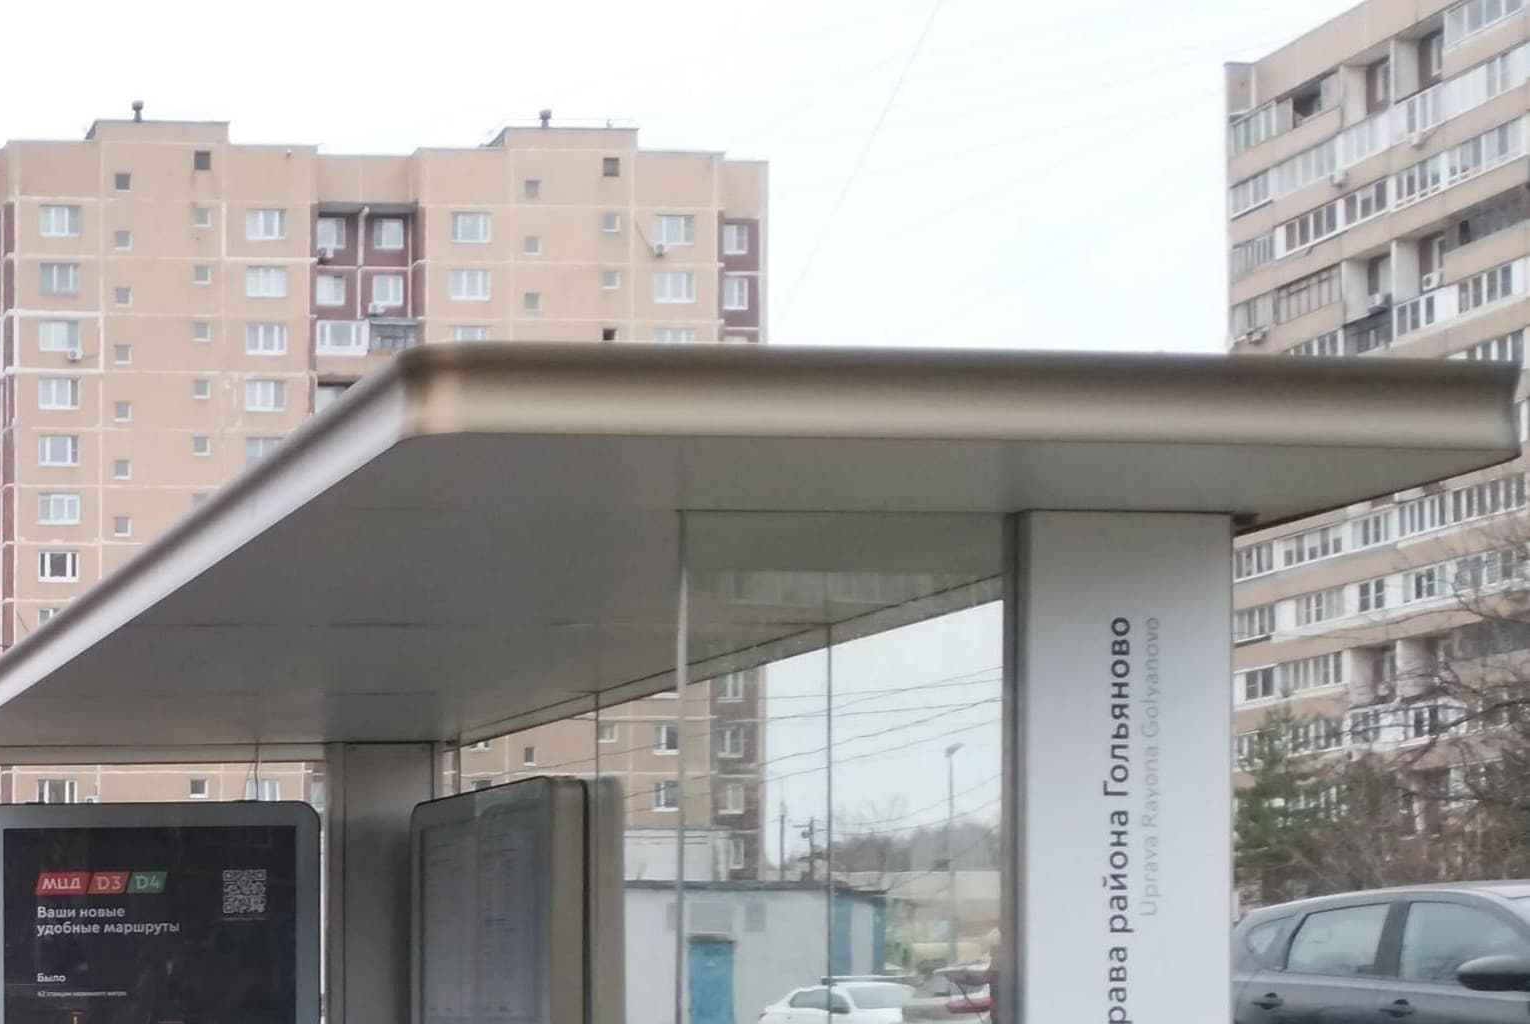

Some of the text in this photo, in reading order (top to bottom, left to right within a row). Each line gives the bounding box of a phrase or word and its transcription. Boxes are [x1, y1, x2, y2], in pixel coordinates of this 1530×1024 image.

[1102, 616, 1132, 797] Гольяново
[1140, 617, 1163, 917] Uprava Rayona Golyanovo
[1102, 809, 1134, 934] района
[42, 876, 161, 891] МЦД D3 D4
[37, 905, 126, 919] Ваши новые
[36, 921, 180, 937] удобные маршруты
[37, 972, 67, 983] Было
